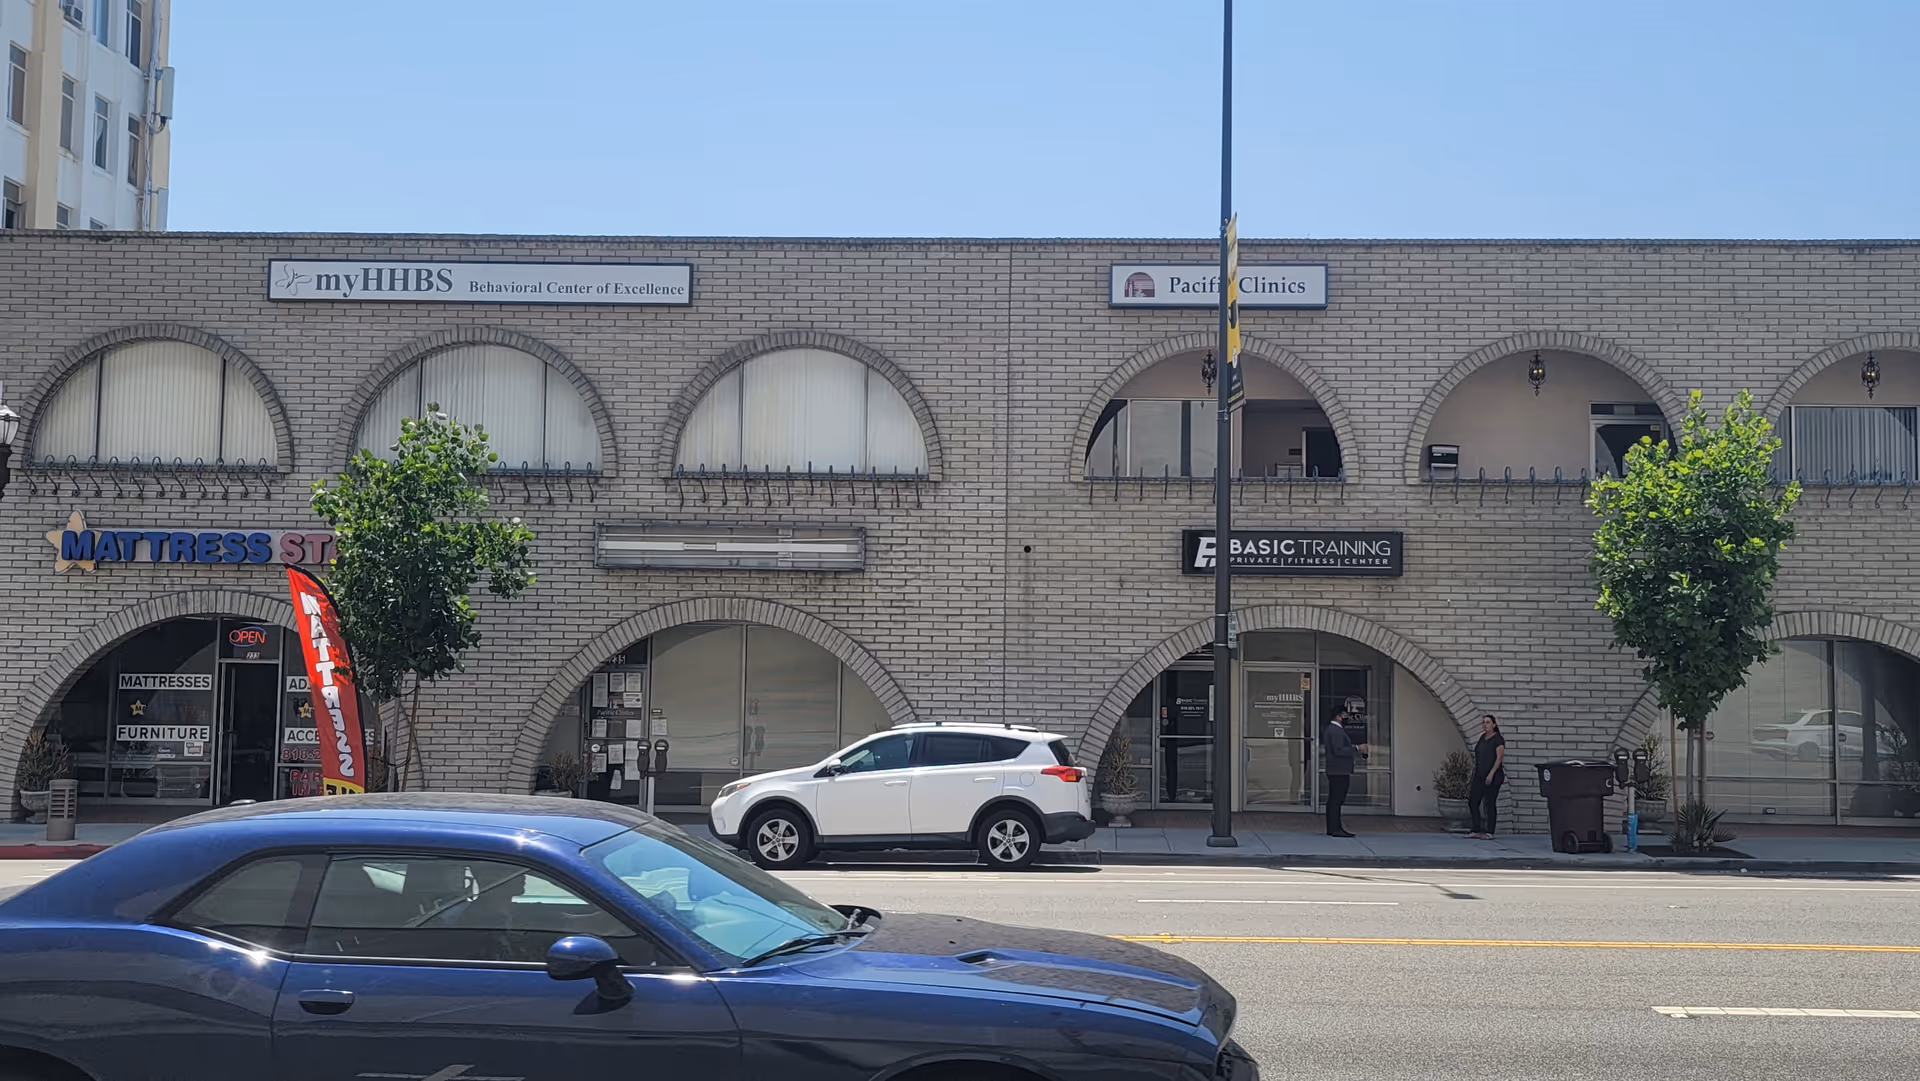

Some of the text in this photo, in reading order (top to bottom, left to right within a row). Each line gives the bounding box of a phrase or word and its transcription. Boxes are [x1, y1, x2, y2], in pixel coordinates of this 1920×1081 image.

[315, 267, 685, 297] myHHBS Behavioral Center of Excellence
[1169, 276, 1306, 293] Pacifi Clinics
[61, 530, 273, 563] MATTRESS
[1230, 539, 1391, 556] BASIC TRAINING
[1288, 557, 1335, 565] FITNESS
[229, 630, 266, 644] OPEN
[120, 675, 210, 688] MATTRESSES
[118, 727, 208, 740] FURNITURE
